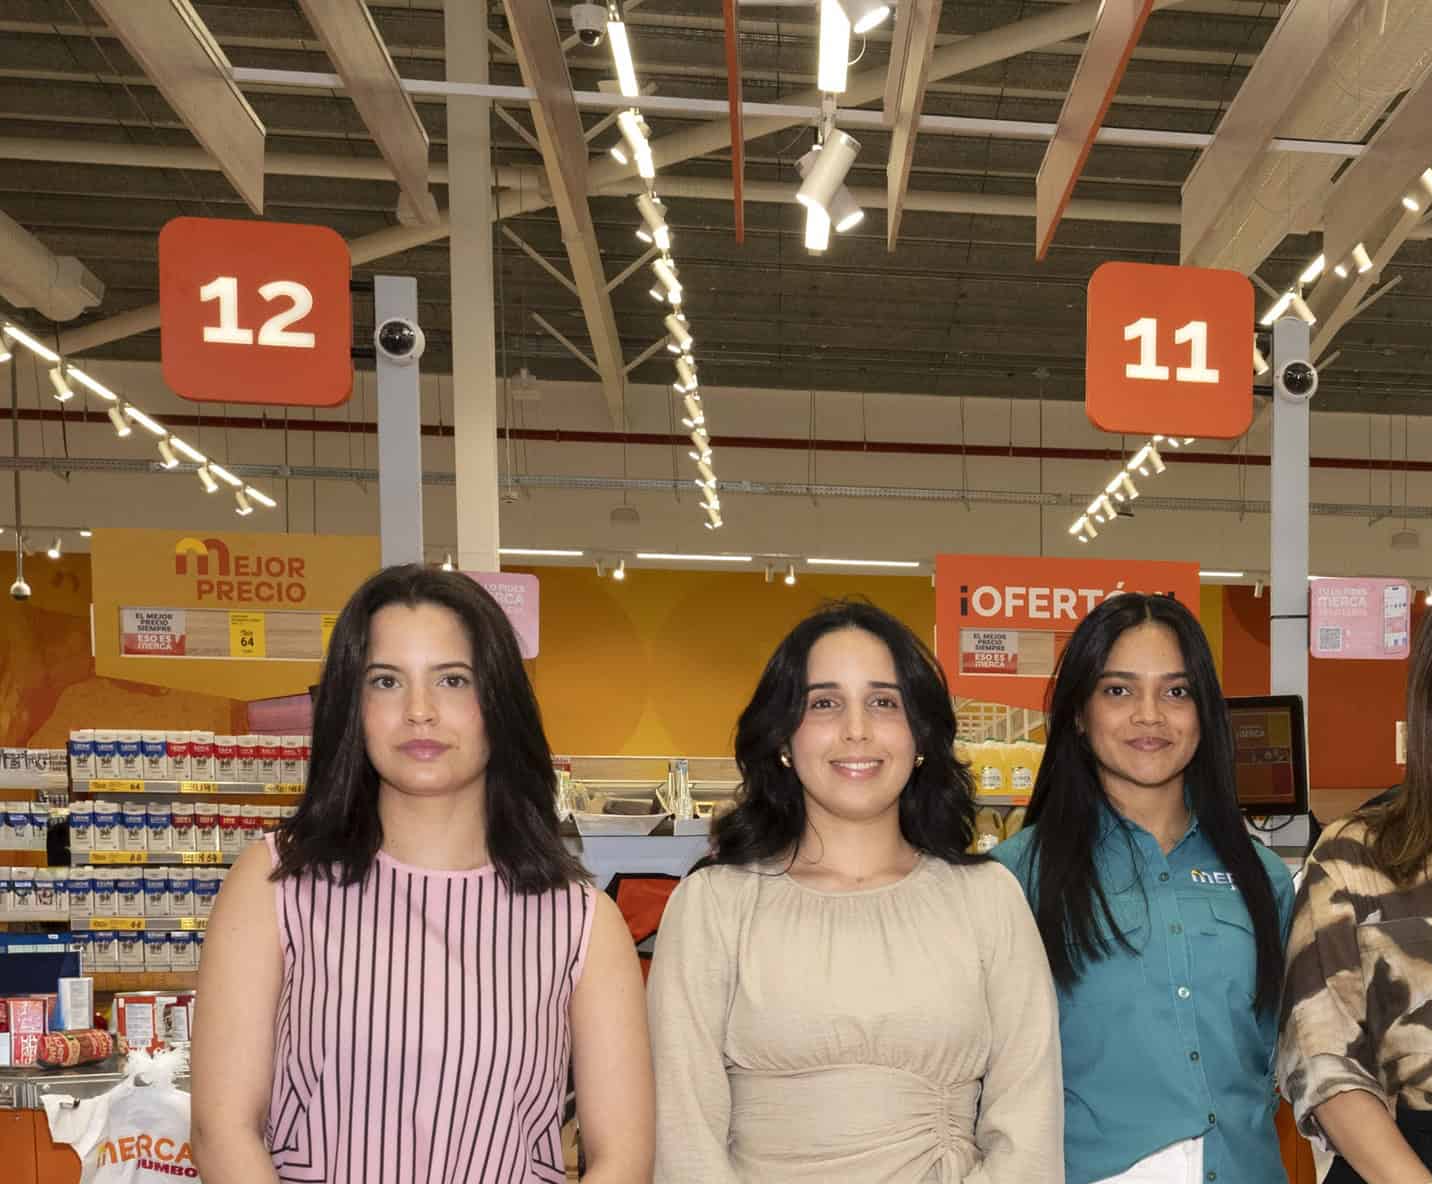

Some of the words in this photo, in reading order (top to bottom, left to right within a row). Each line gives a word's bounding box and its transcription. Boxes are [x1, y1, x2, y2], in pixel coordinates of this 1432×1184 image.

[200, 276, 316, 348] 12
[1124, 317, 1219, 384] 11
[175, 537, 305, 578] MEJOR
[196, 579, 307, 603] PRECIO
[960, 581, 1175, 620] ¡OFERT
[135, 612, 145, 620] EL
